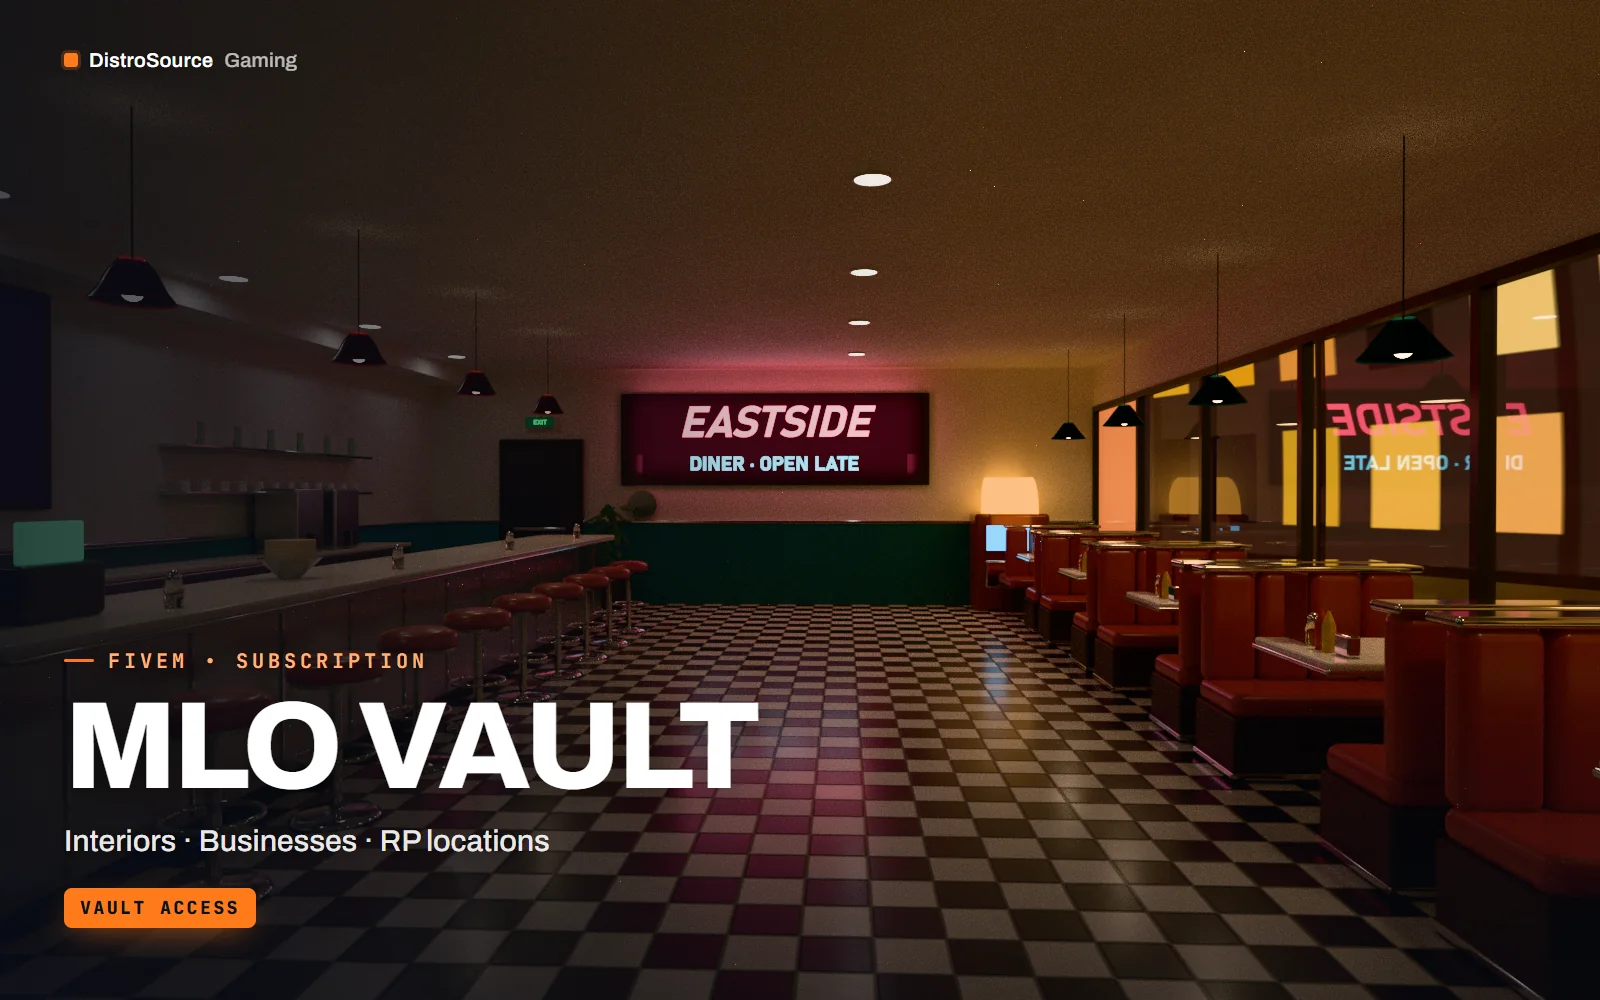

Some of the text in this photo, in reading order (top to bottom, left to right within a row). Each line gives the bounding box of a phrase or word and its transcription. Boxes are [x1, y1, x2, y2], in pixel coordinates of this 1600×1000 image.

[532, 418, 548, 426] EXIT
[681, 405, 876, 439] EASTSIDE
[689, 455, 860, 472] DINER OPEN LATE
